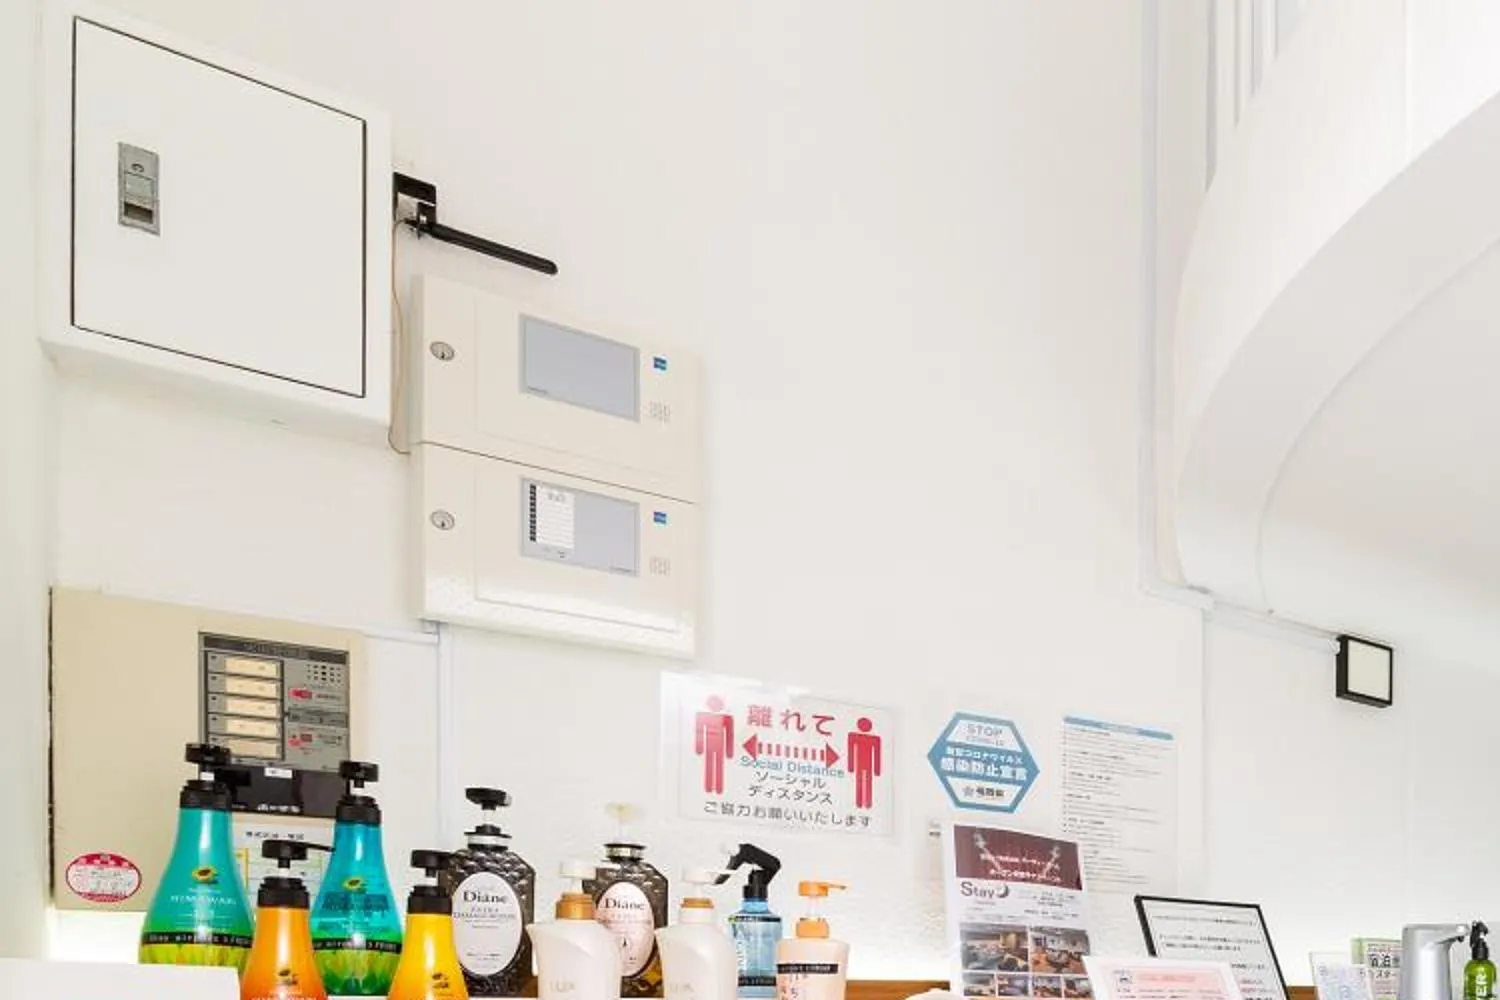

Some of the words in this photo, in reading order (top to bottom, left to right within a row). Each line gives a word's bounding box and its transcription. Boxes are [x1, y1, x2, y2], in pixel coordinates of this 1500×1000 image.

[747, 704, 835, 737] 離れて
[740, 756, 783, 770] Social
[787, 760, 845, 778] Distance
[755, 771, 827, 789] ソーシャル
[748, 785, 833, 805] ディスタンス
[704, 801, 871, 827] ご協力お願いいたします
[960, 881, 995, 898] Stay
